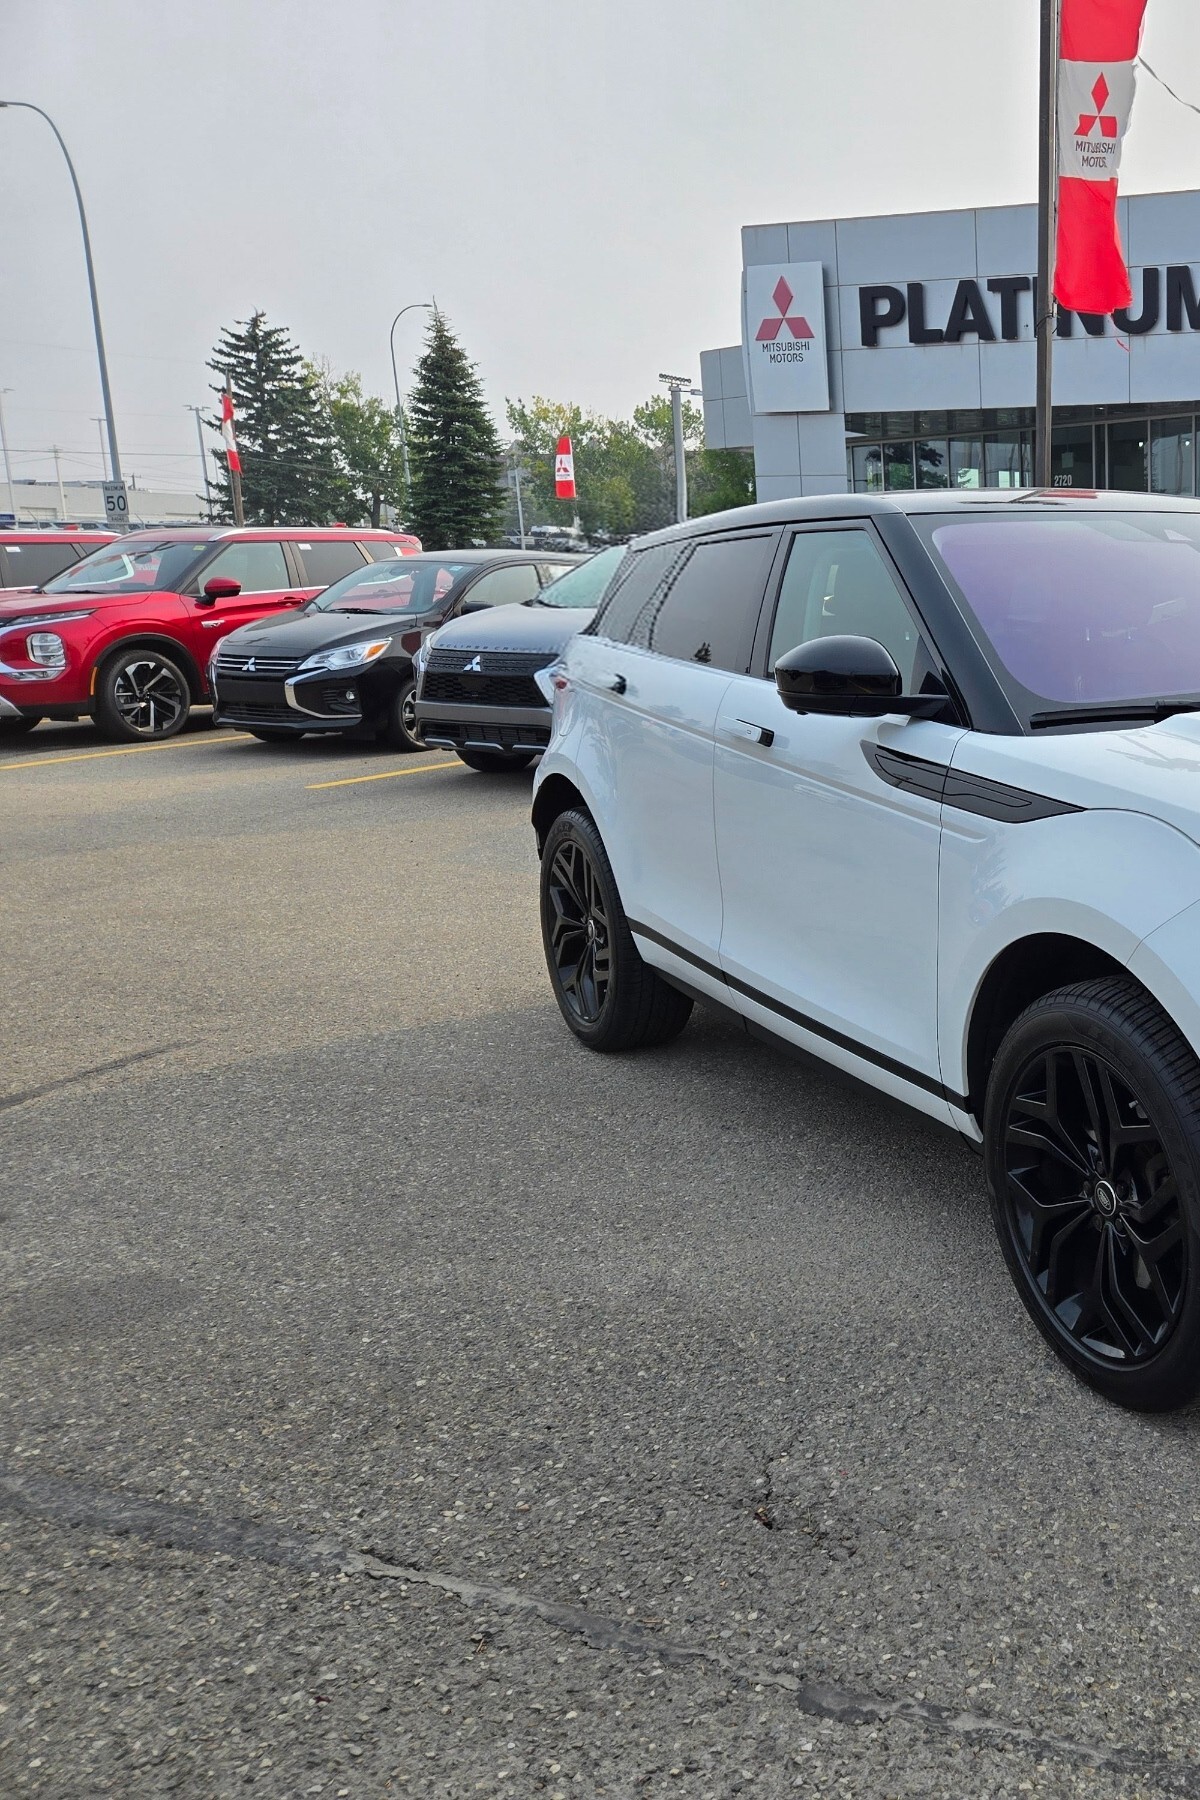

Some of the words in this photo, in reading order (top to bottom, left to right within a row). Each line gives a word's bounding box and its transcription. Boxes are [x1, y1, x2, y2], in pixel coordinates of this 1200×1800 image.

[762, 341, 810, 353] MITSUBISHI
[769, 352, 804, 363] MOTORS
[1054, 474, 1072, 487] 2720
[106, 495, 127, 512] 50
